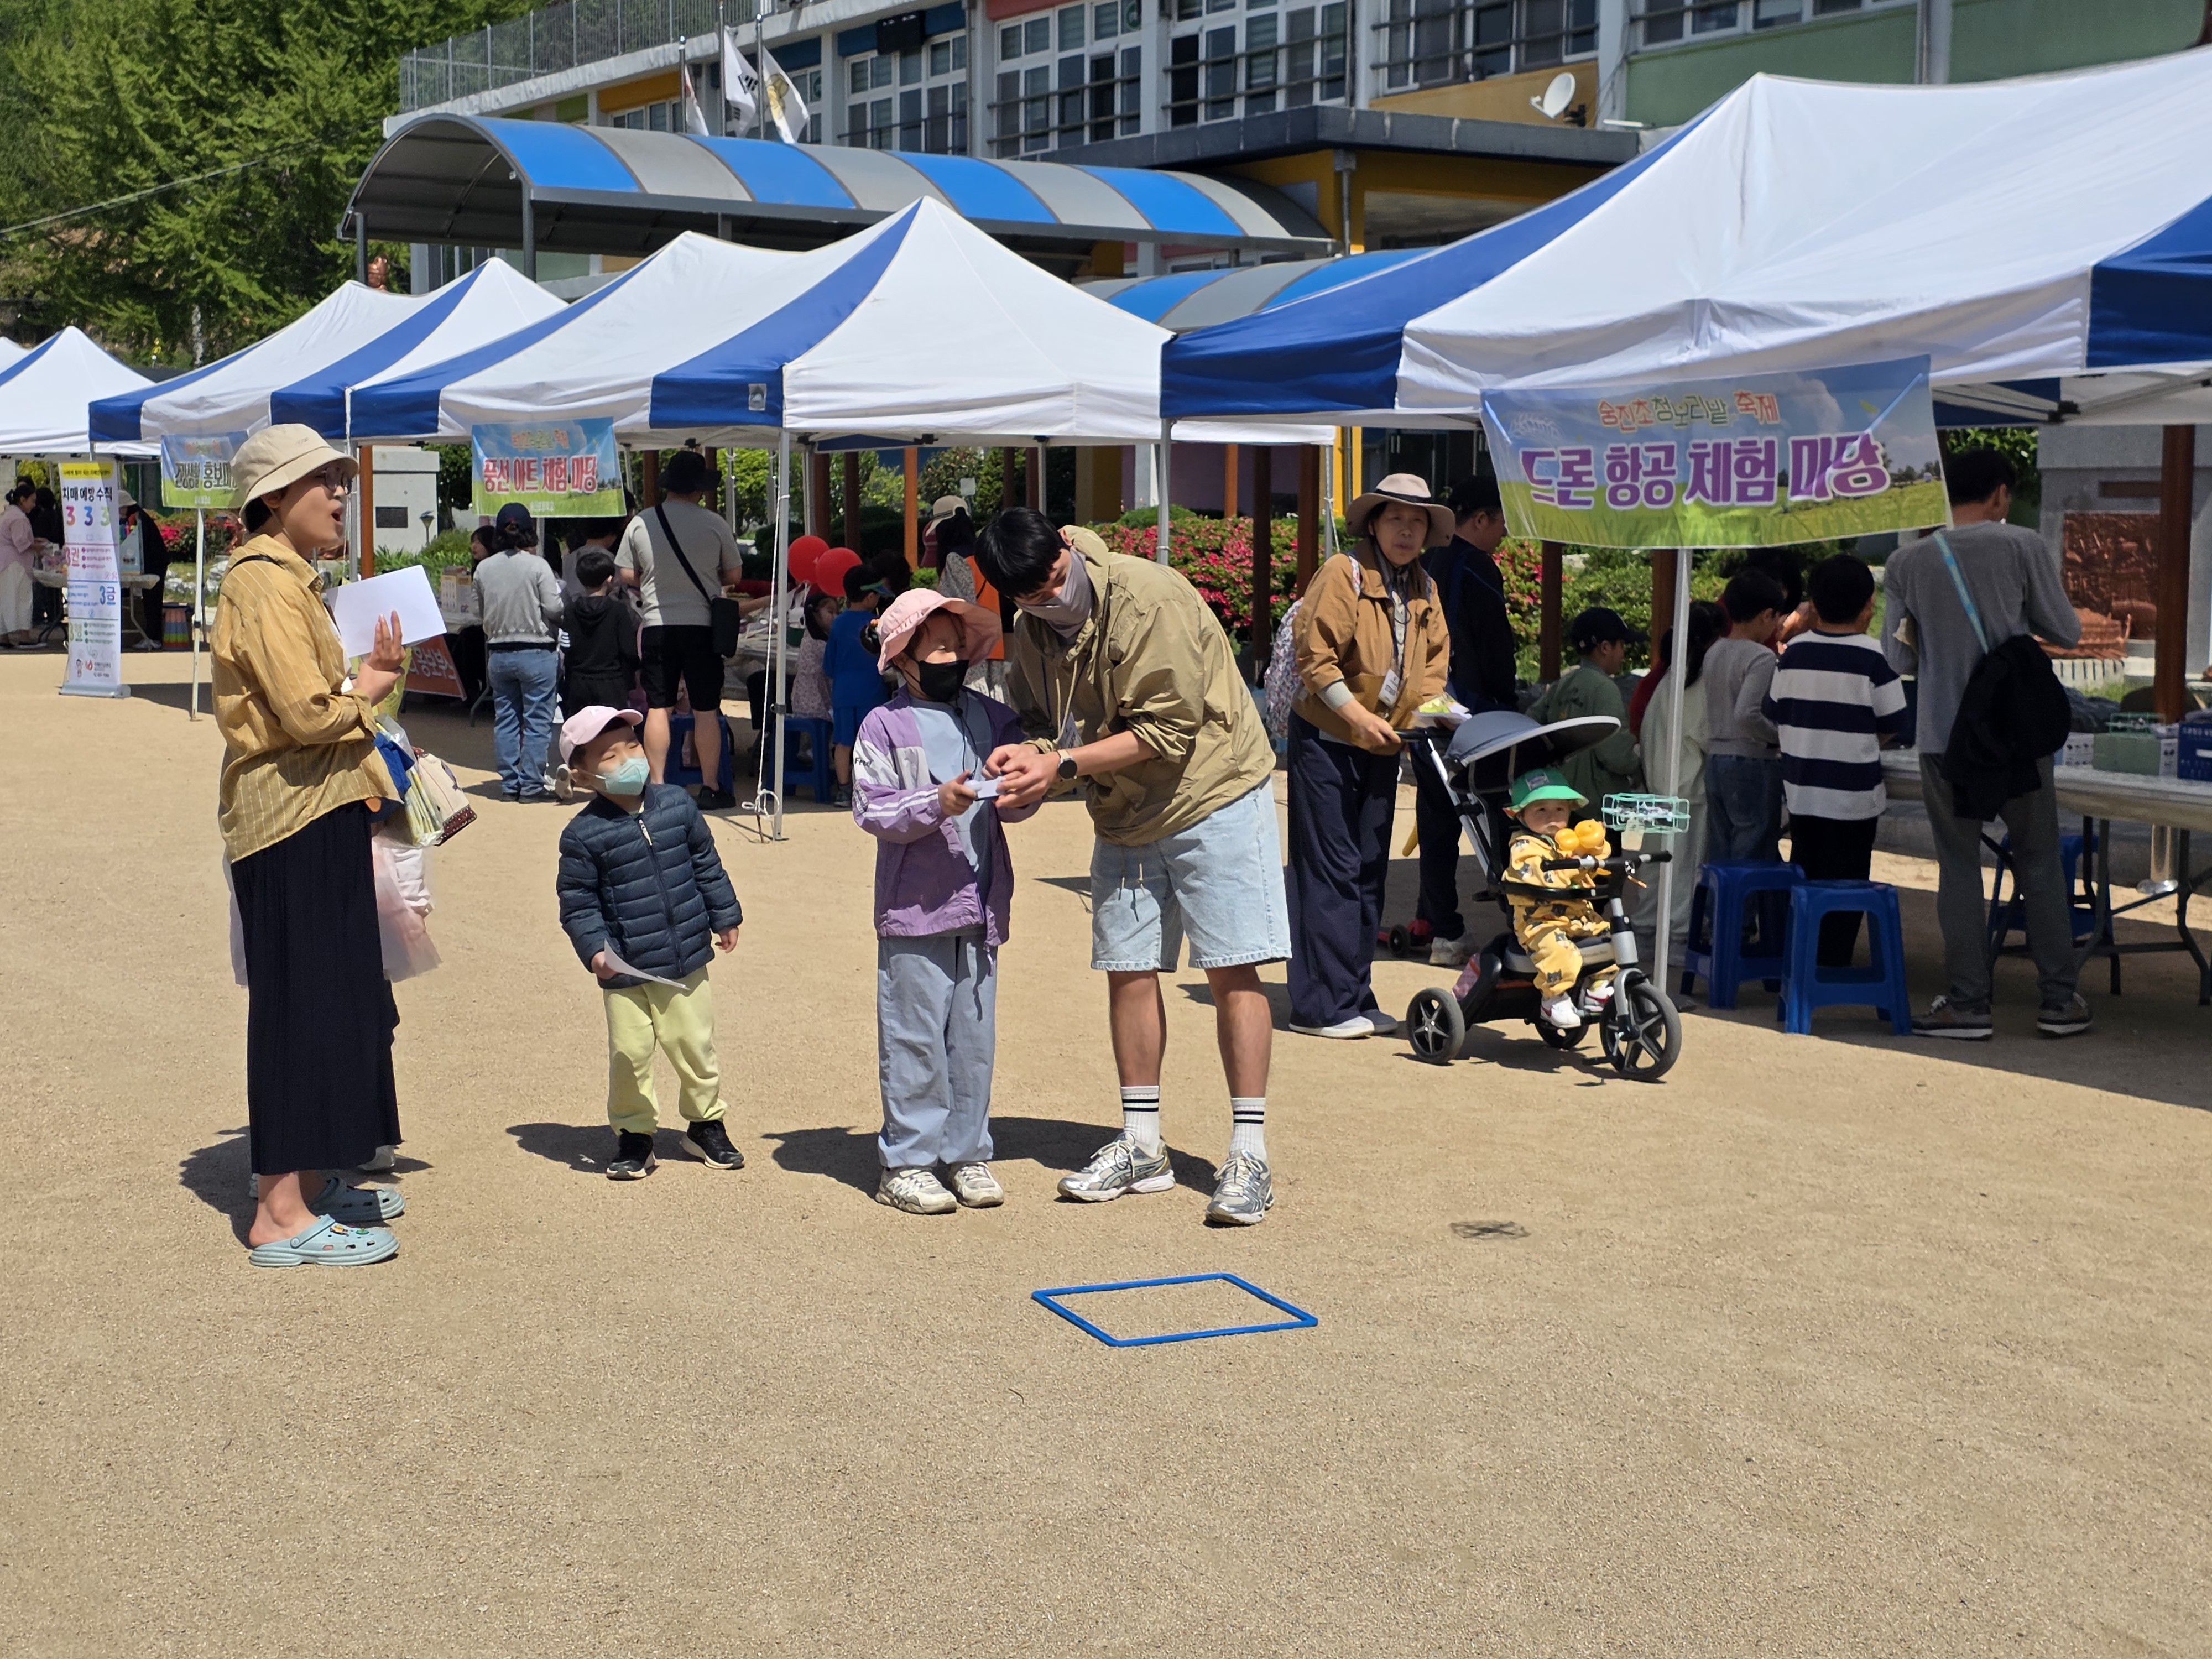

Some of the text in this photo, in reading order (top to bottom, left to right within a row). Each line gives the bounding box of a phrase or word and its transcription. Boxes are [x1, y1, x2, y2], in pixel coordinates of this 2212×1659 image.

[1734, 392, 1778, 422] 축제
[204, 461, 238, 489] 홍보마
[484, 455, 597, 492] 풍선 아트 체험 마당
[1521, 432, 1880, 508] 드론 항공 체험 마당
[63, 486, 112, 502] 치매 예방 수칙
[66, 505, 110, 527] 3 3 3
[100, 585, 117, 606] 3금
